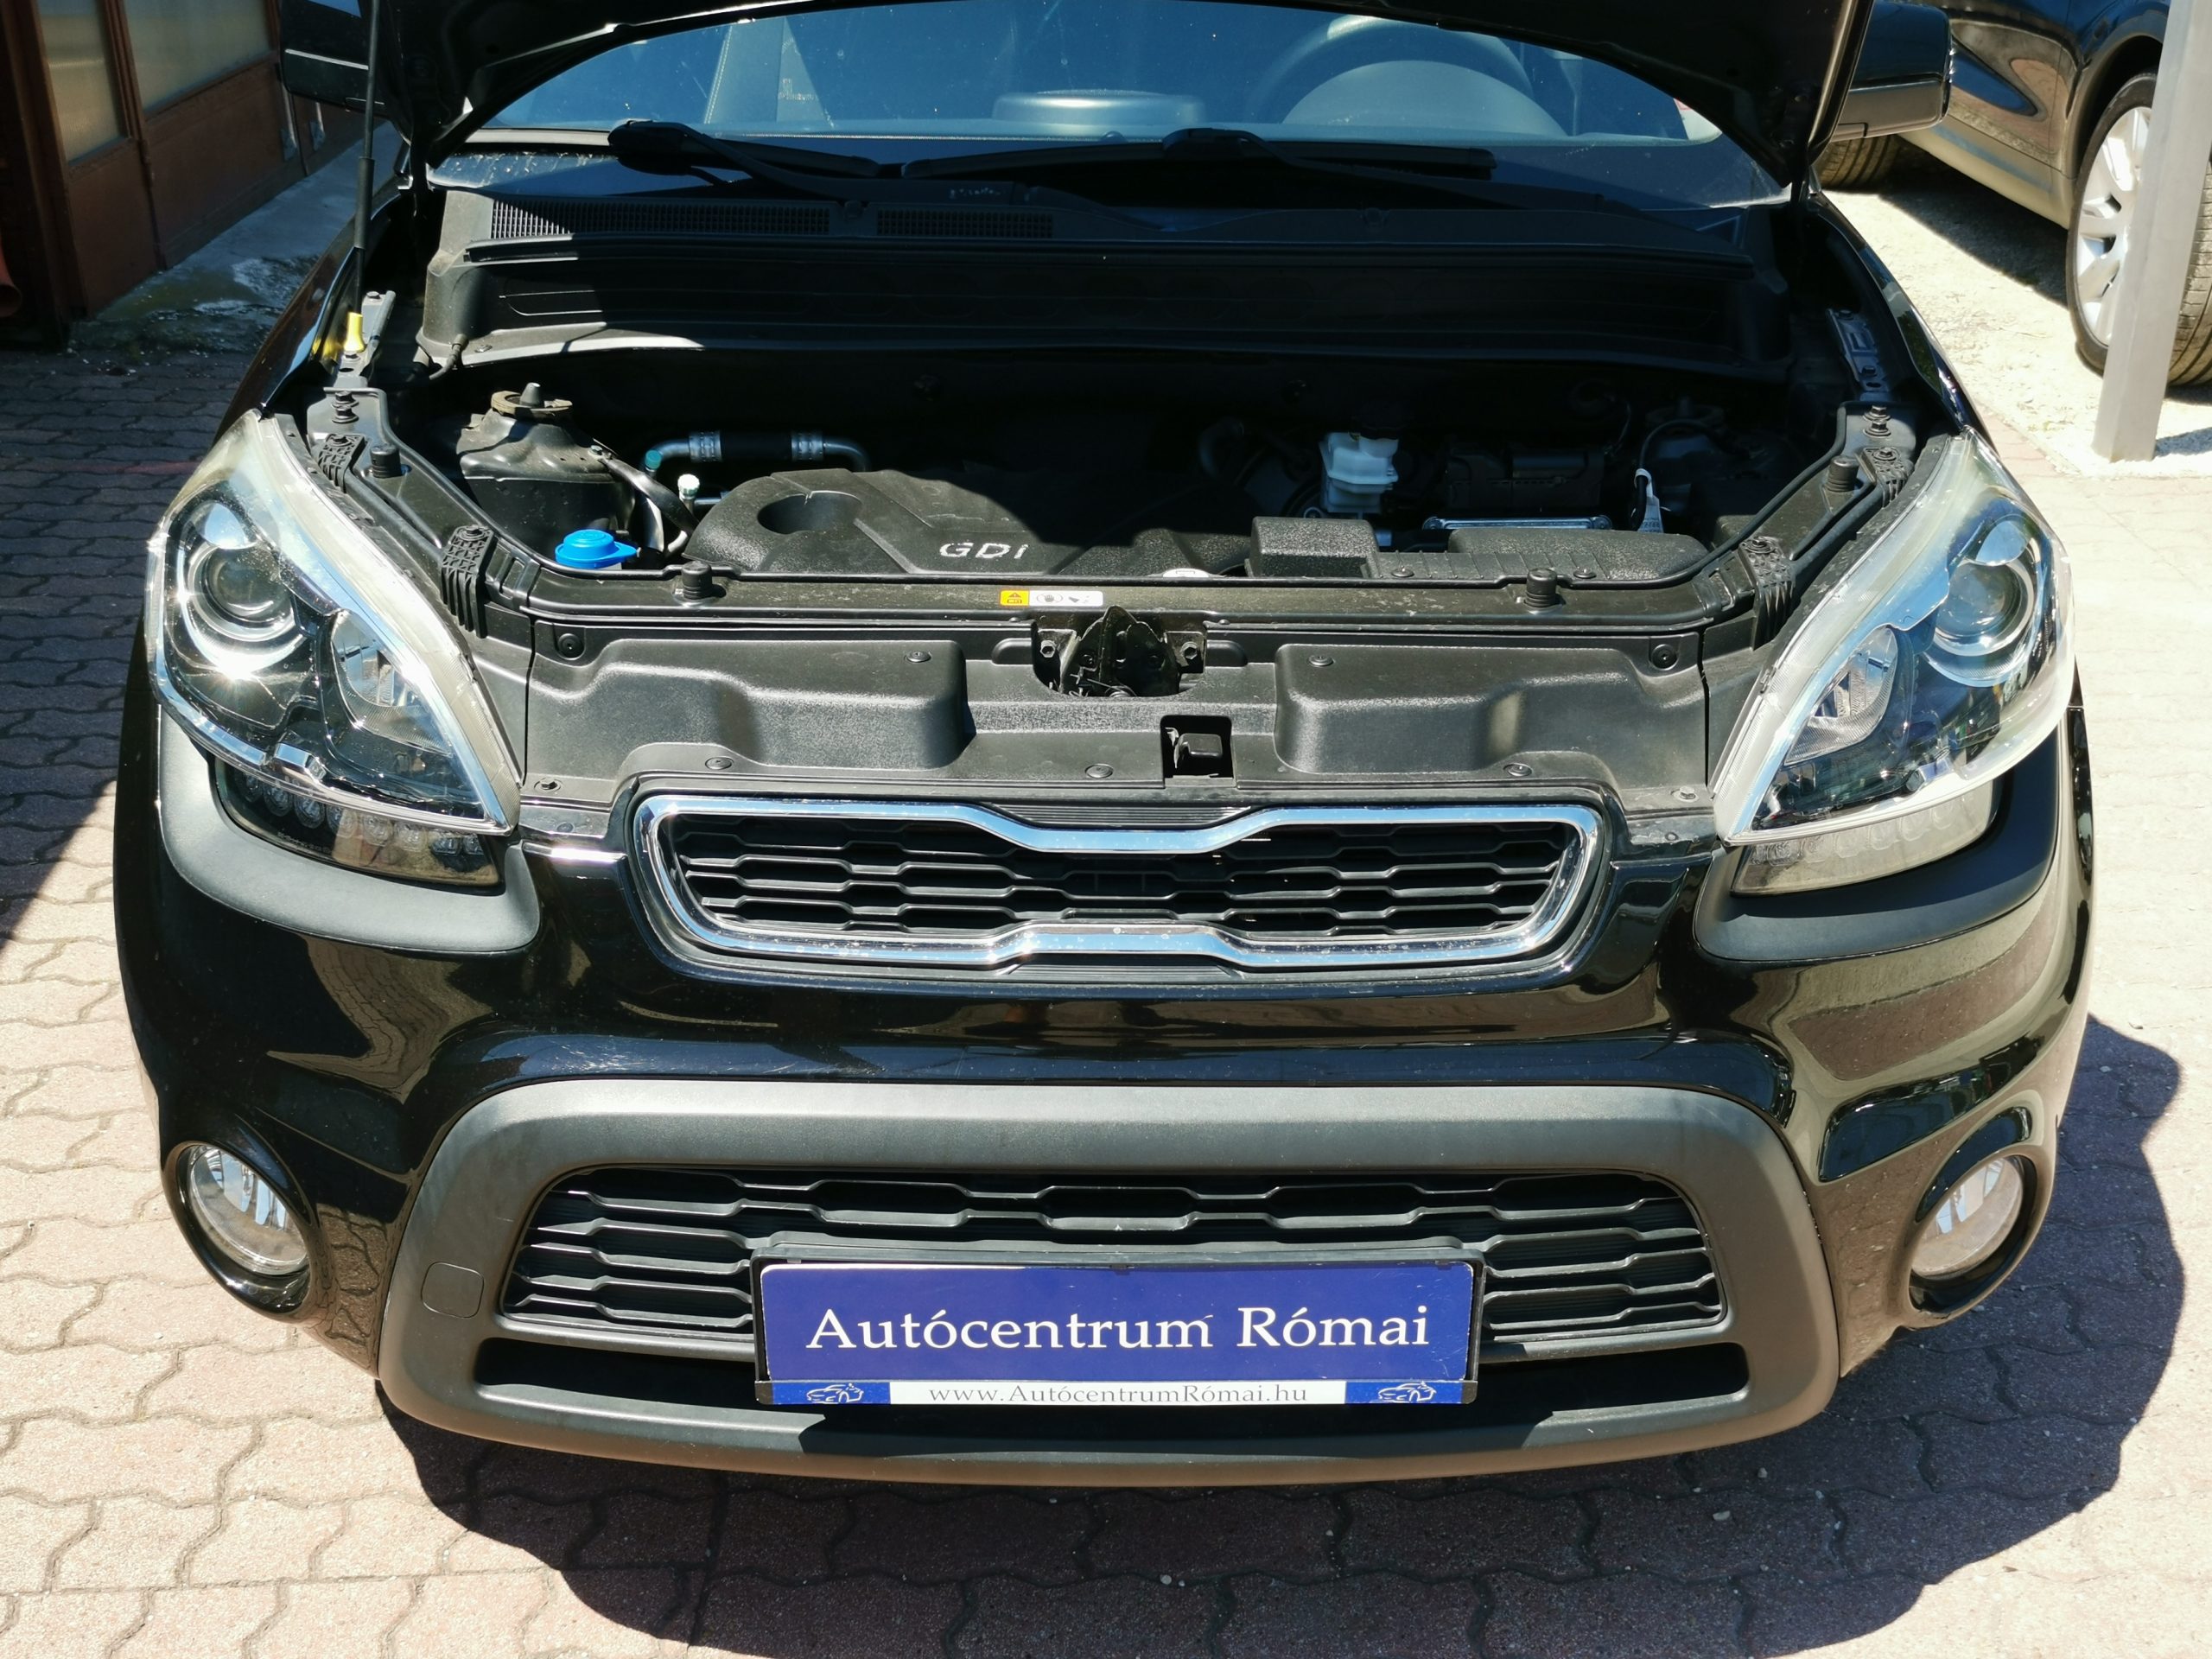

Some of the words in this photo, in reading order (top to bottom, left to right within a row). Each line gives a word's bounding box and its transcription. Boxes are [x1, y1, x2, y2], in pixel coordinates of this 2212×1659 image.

[939, 542, 1029, 559] GDI
[805, 1308, 1213, 1349] Autócentrum
[1237, 1305, 1430, 1347] Római
[929, 1384, 1307, 1403] www.AutócentrumRómai.hu
